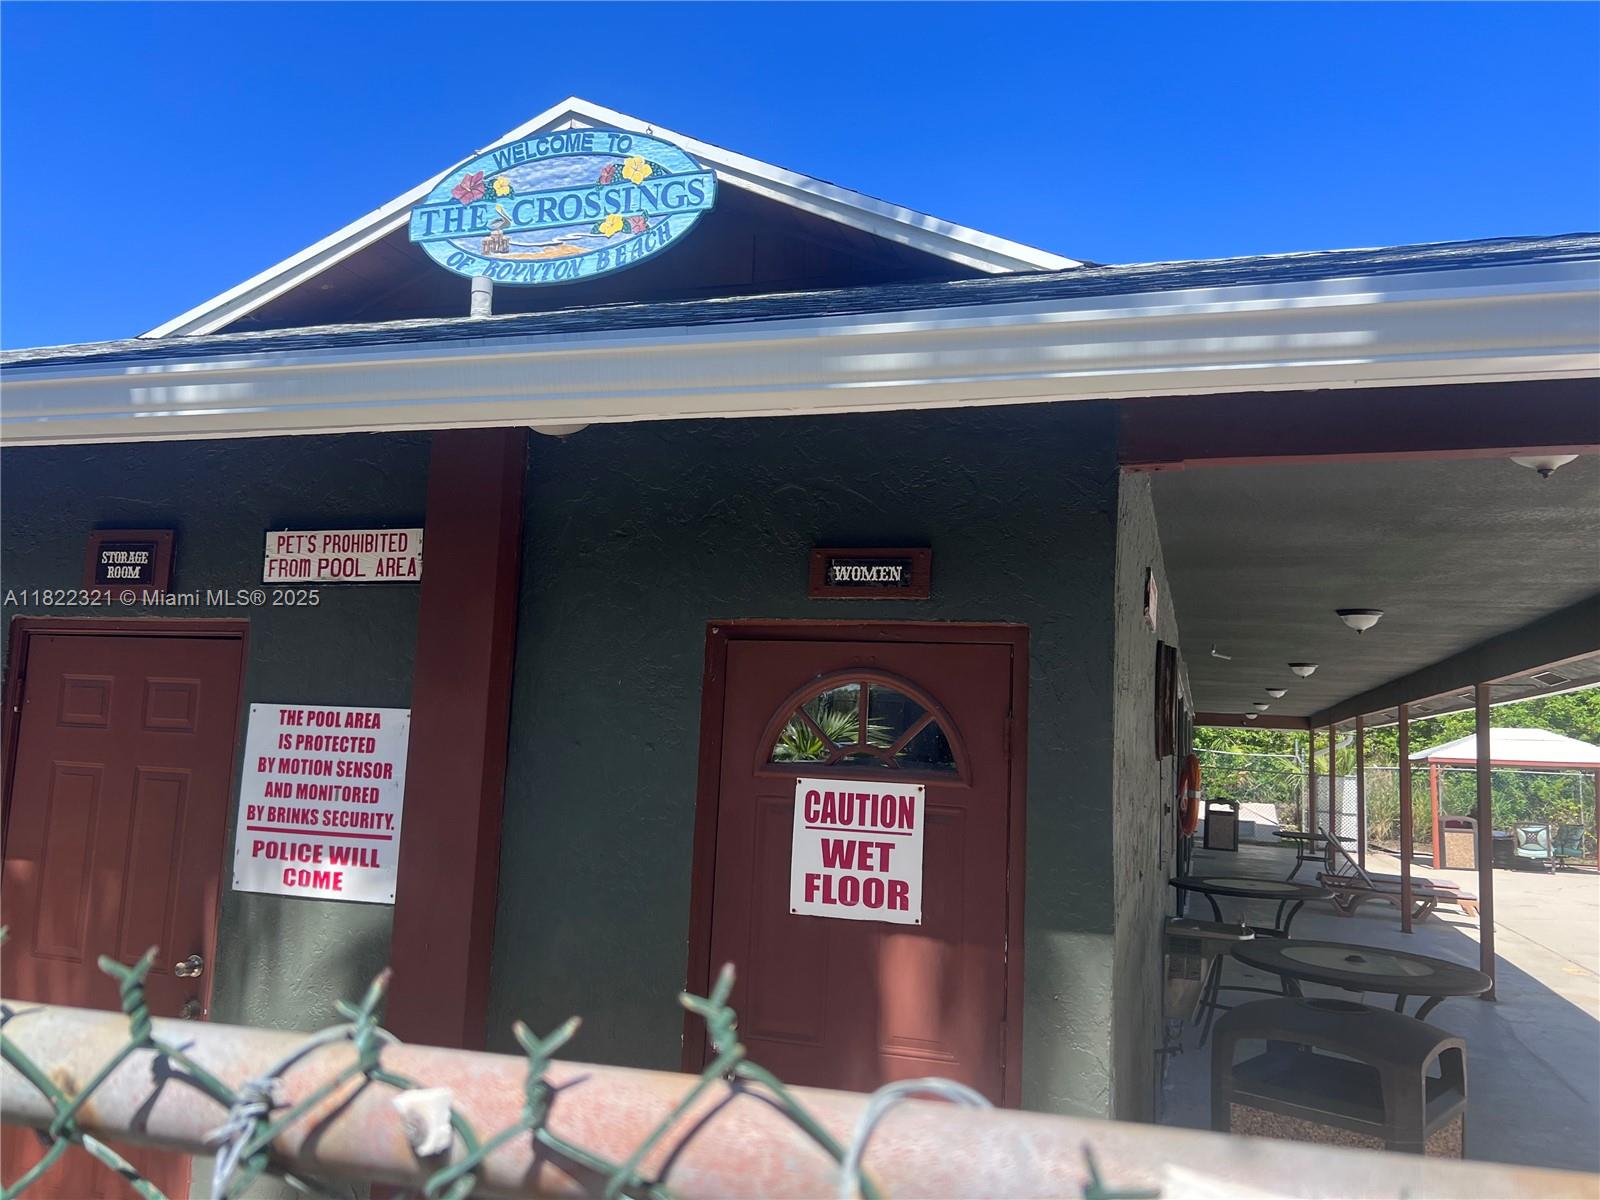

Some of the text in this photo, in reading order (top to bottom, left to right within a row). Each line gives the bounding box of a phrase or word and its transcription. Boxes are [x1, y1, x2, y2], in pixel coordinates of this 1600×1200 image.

[493, 132, 633, 170] WELCOME TO
[420, 177, 706, 236] THE CROSSINGS
[447, 220, 672, 282] OF BOYNTON BEACH
[277, 532, 408, 554] PET'S PROHIBITED
[102, 551, 149, 564] STORAGE
[317, 557, 366, 578] POOL
[375, 556, 417, 577] AREA
[107, 566, 141, 579] ROOM
[833, 566, 903, 581] WOMEN
[279, 709, 381, 729] THE POOL AREA
[278, 733, 376, 754] IS PROTECTED
[257, 756, 393, 780] BY MOTION SENSOR
[264, 781, 380, 804] AND MONITORED
[246, 804, 395, 831] BY BRINKS SECURITY.
[804, 790, 915, 830] CAUTION
[252, 839, 381, 868] POLICE WILL
[820, 838, 896, 873] WET
[282, 868, 343, 891] COME
[804, 873, 910, 912] FLOOR
